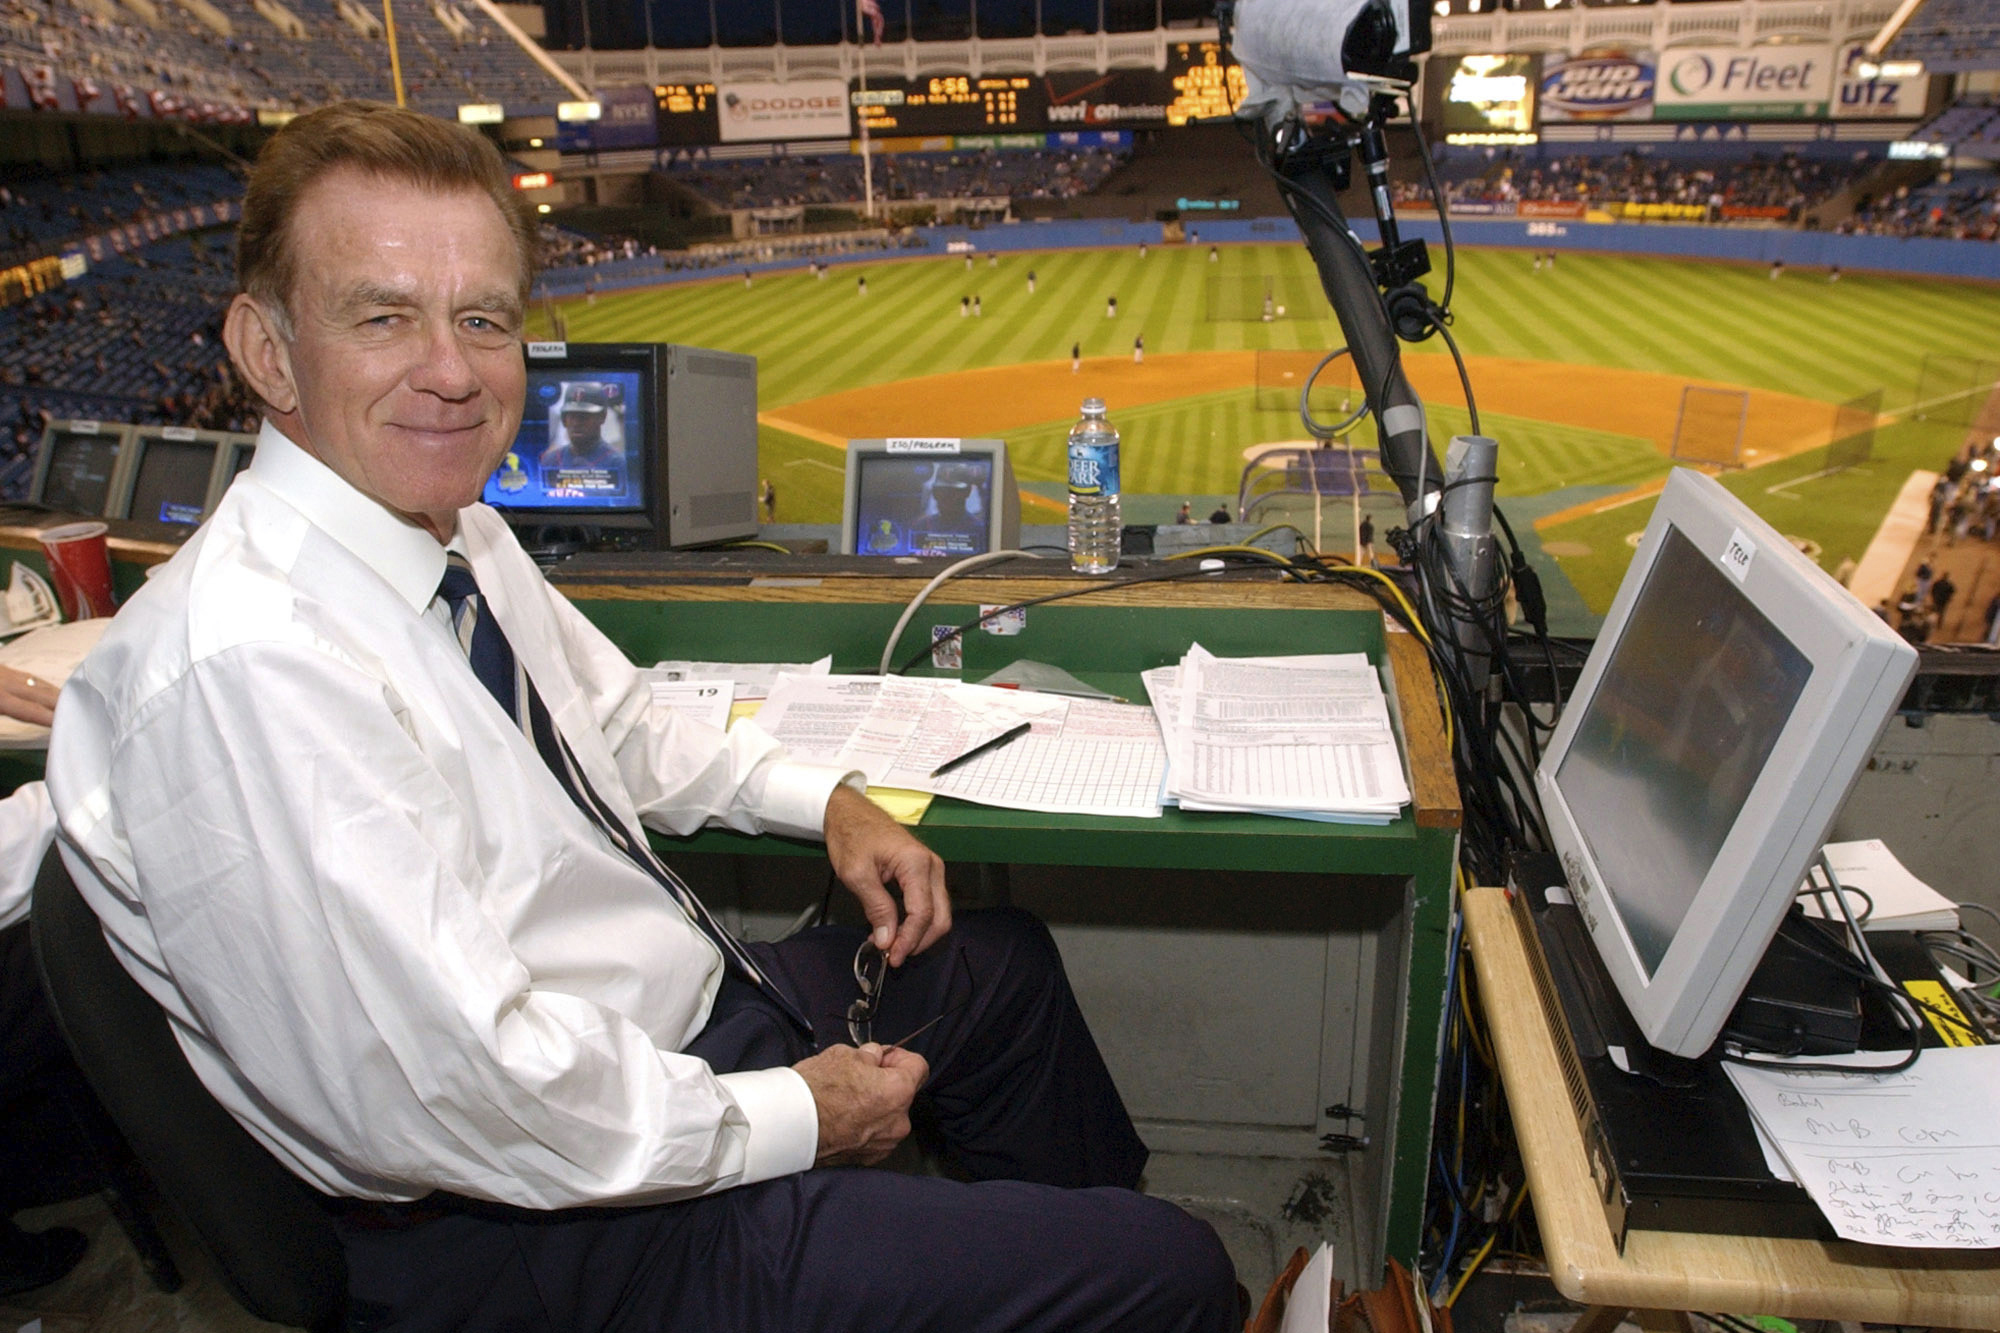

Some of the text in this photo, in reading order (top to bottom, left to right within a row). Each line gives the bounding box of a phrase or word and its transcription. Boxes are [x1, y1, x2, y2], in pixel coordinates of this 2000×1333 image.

[1560, 64, 1640, 83] BUD
[1722, 57, 1815, 90] Fleet
[1541, 80, 1654, 100] LIGHT
[752, 96, 842, 111] DODGE
[1047, 100, 1120, 124] verizon
[698, 688, 718, 697] 19
